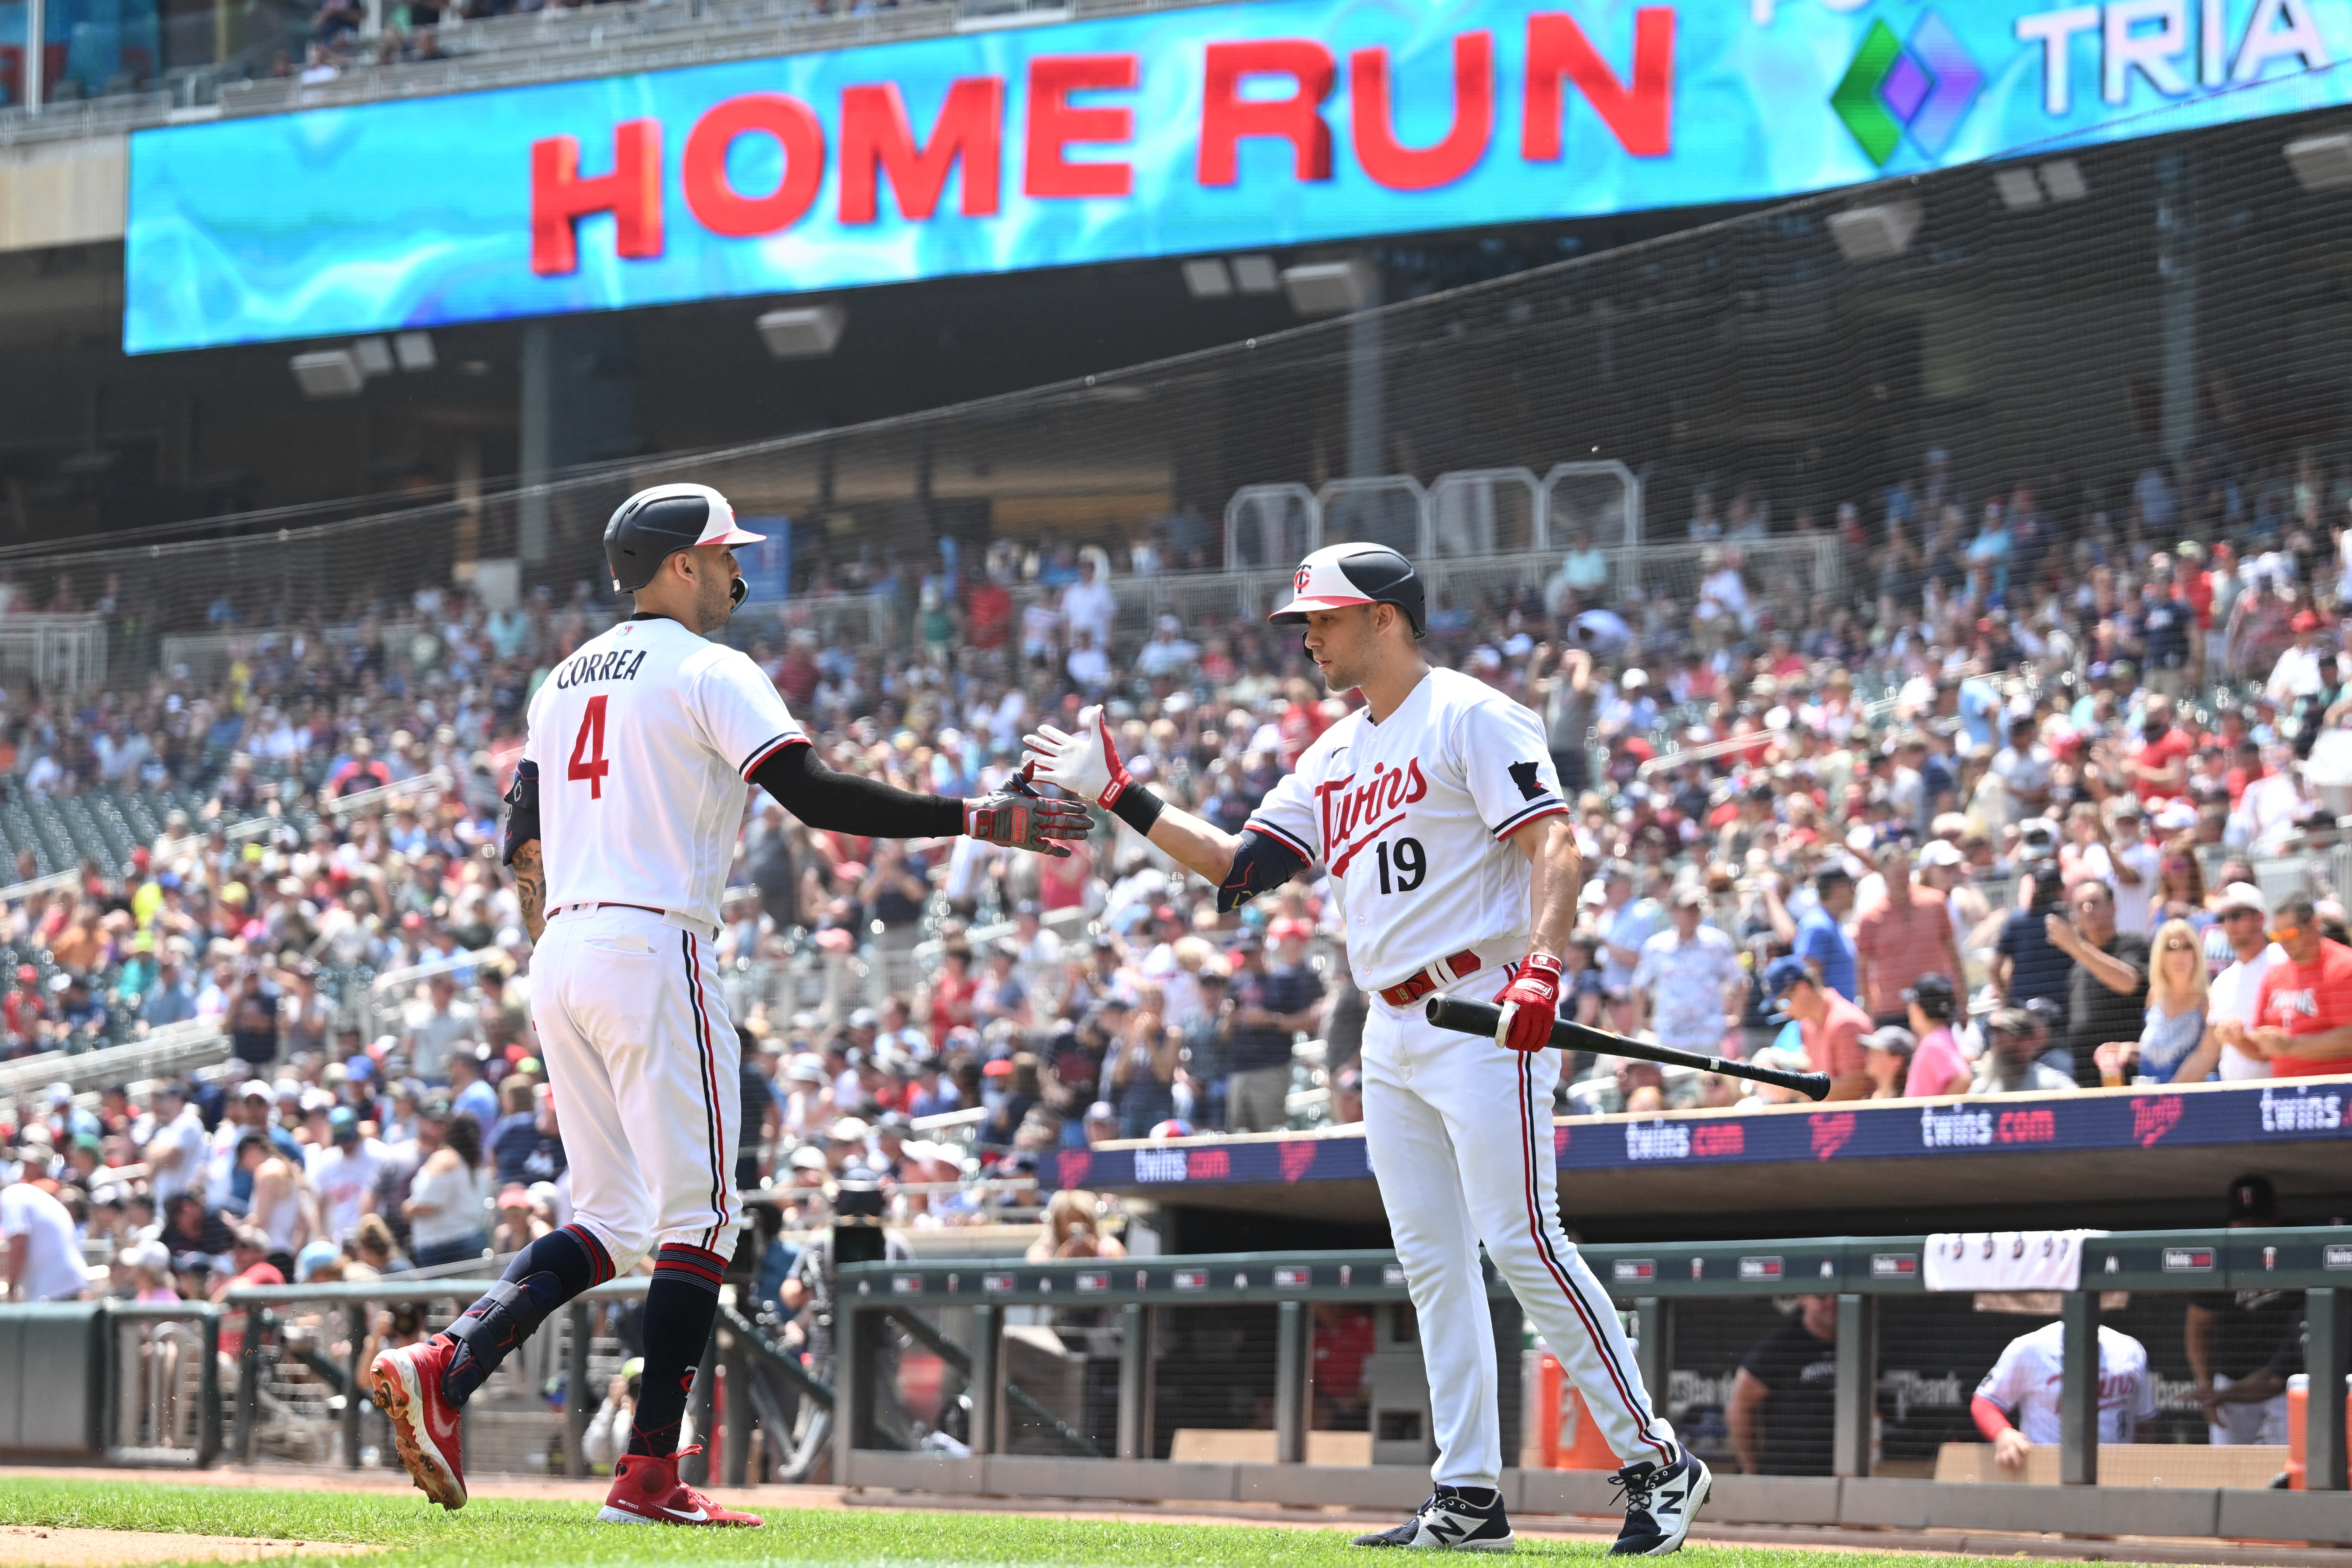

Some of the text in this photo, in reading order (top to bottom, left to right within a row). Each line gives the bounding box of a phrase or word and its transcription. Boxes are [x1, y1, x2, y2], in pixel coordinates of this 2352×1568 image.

[2015, 0, 2331, 115] TRIA
[531, 6, 1675, 275] HOME RUN
[557, 649, 647, 689] CORREA
[568, 694, 609, 800] 4
[1015, 808, 1025, 841] Franklin
[1314, 756, 1427, 867] Twins
[1375, 837, 1427, 894] 19
[1396, 988, 1409, 1001] 19
[1521, 980, 1552, 996] Frank
[1921, 1103, 2055, 1147] twins.com
[2260, 1085, 2352, 1132] twins.
[1657, 1491, 1685, 1514] N
[1426, 1515, 1467, 1545] N
